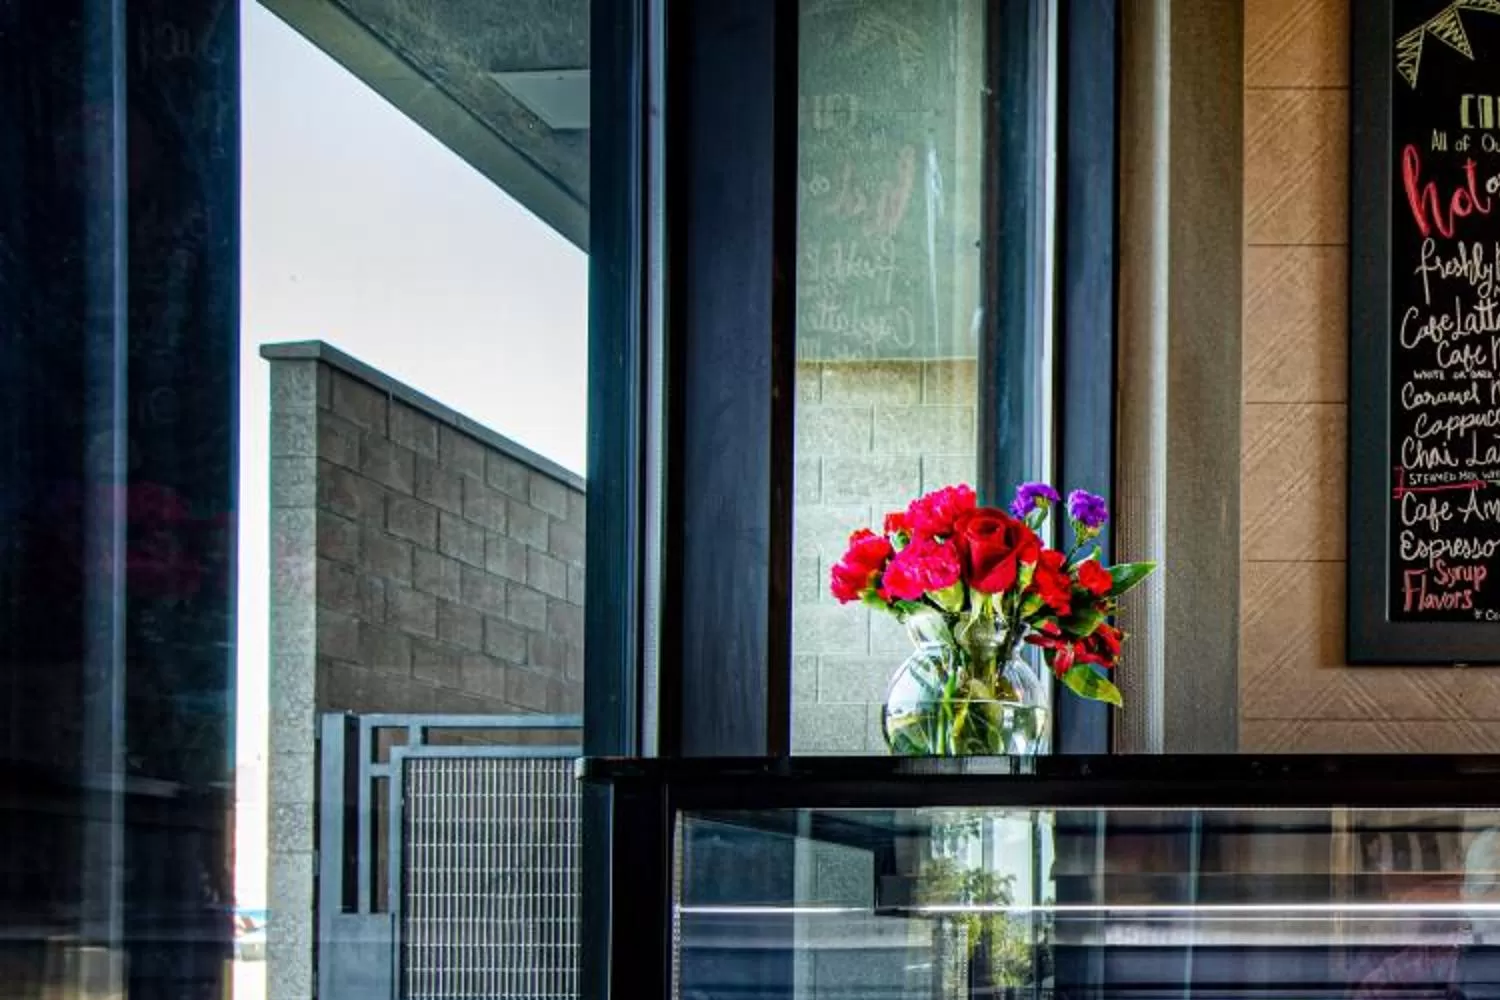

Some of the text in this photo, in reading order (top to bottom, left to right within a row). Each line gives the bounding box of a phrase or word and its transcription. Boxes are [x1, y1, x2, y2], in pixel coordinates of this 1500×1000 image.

[1431, 128, 1447, 152] All
[1454, 133, 1471, 152] of
[1403, 143, 1491, 239] hot
[1400, 306, 1455, 349] Cafe
[1437, 340, 1487, 372] Cafe
[1401, 381, 1481, 410] Caramel
[1401, 435, 1459, 470] Chai
[1409, 471, 1457, 486] STEAMED
[1401, 491, 1453, 533] Cafe
[1402, 568, 1473, 612] Flavors
[1434, 559, 1487, 591] Syrup
